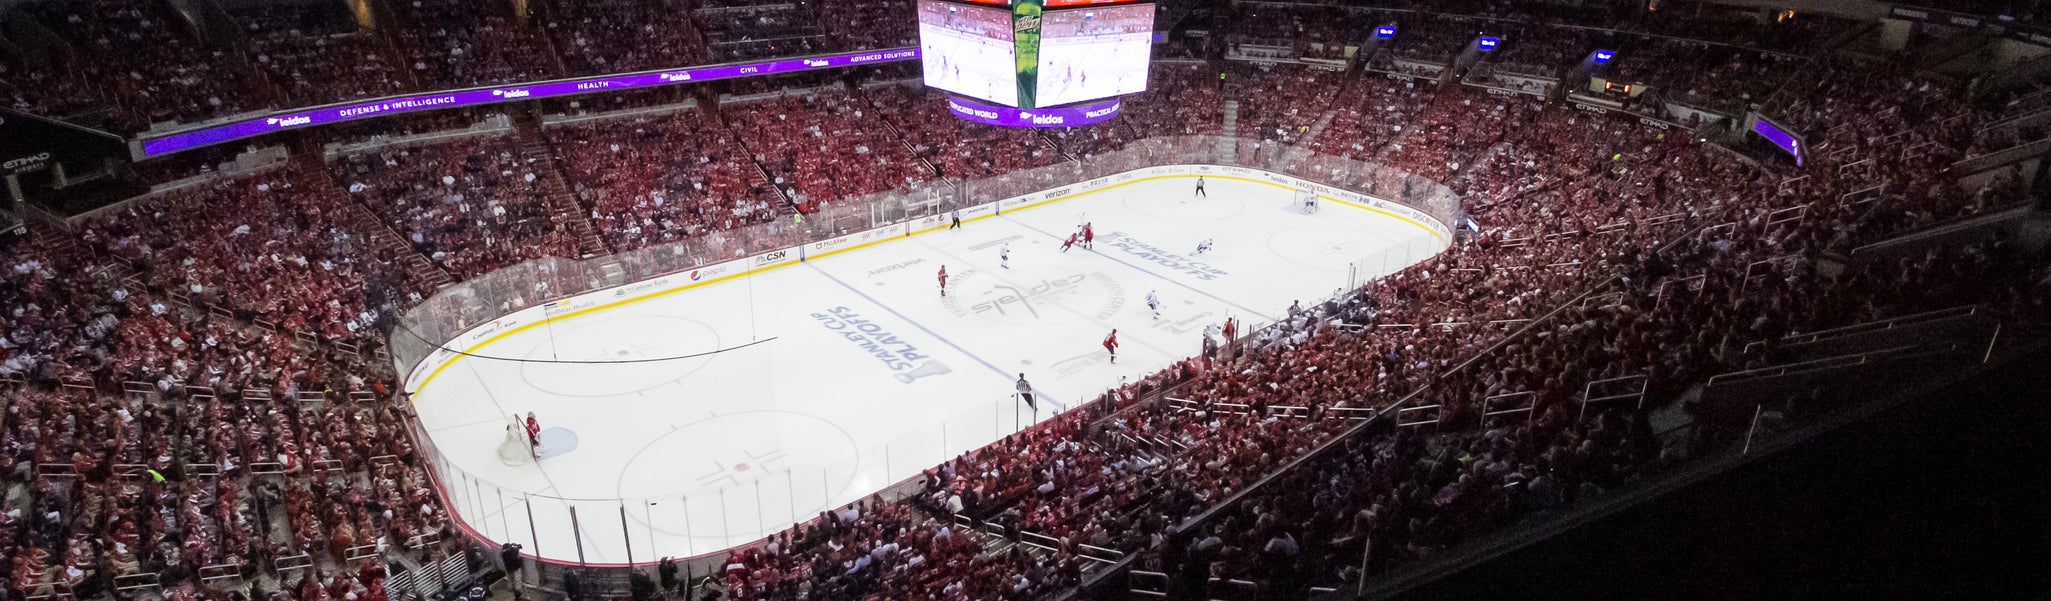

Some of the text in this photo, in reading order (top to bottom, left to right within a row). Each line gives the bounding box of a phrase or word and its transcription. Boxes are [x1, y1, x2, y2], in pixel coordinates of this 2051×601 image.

[811, 59, 829, 67] leidos
[850, 51, 915, 63] ADVANCED SOLUTIONS
[669, 73, 691, 81] leidos
[578, 81, 609, 90] HEALTH
[504, 89, 529, 98] leidos
[340, 105, 380, 117] DEFENSE
[392, 96, 456, 109] INTELLIGENCE
[1576, 103, 1607, 114] ETIHAD
[974, 110, 998, 119] WORLD
[1033, 113, 1064, 125] leidos
[280, 115, 311, 127] leidos
[1640, 117, 1669, 130] ETIHAD
[3, 152, 50, 169] ETIHAD
[1295, 180, 1330, 194] HONDA
[1044, 188, 1071, 199] verizon
[823, 238, 848, 248] McAfee
[766, 251, 786, 261] CSN
[1109, 243, 1218, 280] PLAYOFFS
[1124, 237, 1229, 276] STANLEY CUP
[703, 266, 726, 278] pepsi
[827, 306, 930, 361] PLAYOFFS
[810, 312, 914, 371] STANLEY CUP
